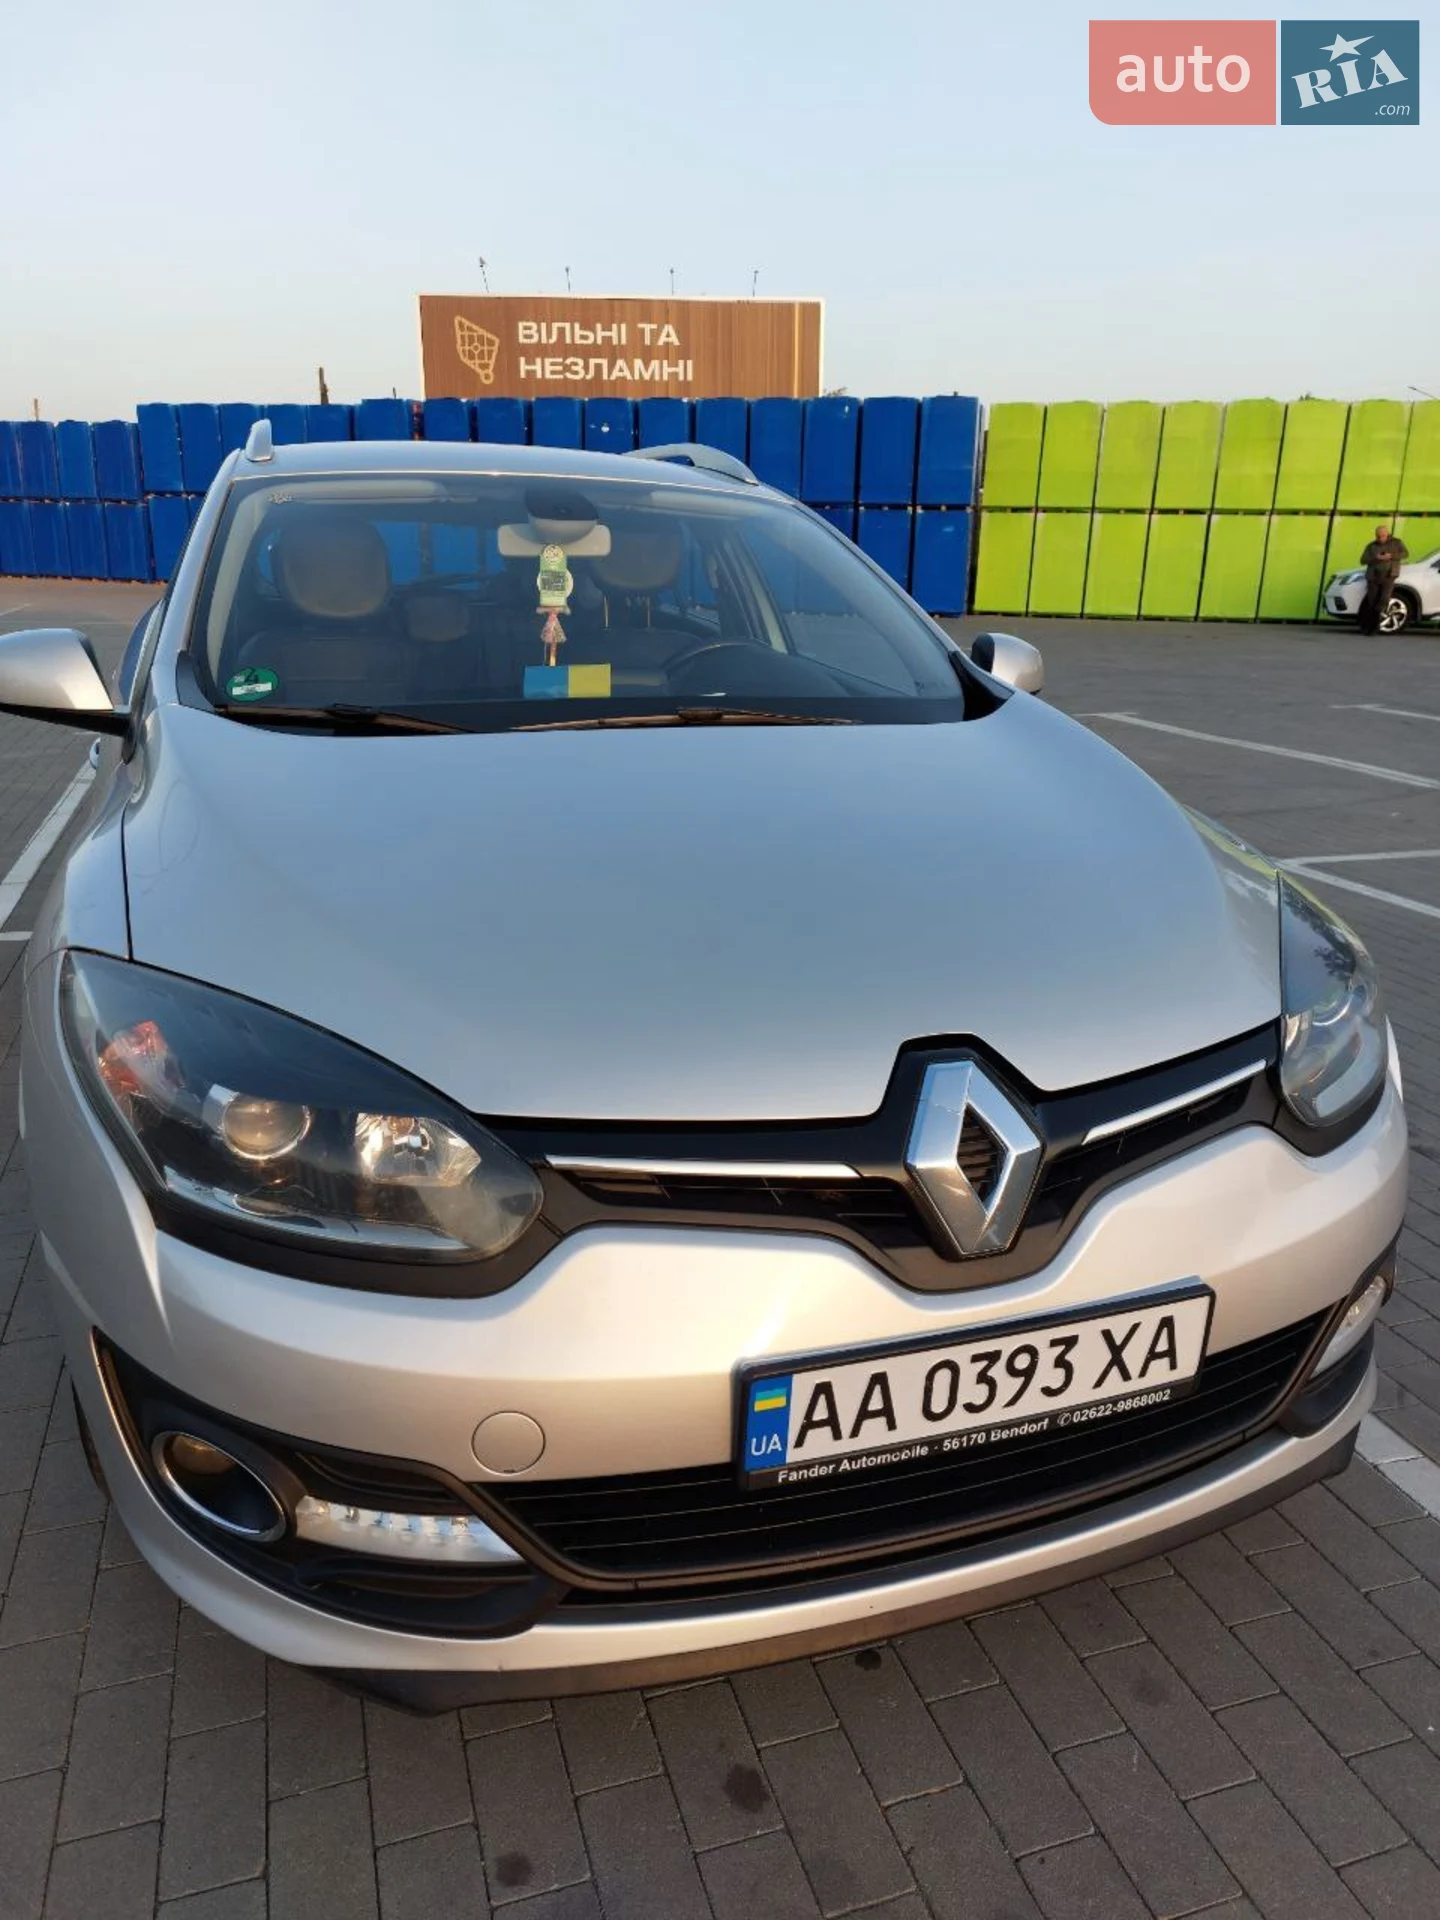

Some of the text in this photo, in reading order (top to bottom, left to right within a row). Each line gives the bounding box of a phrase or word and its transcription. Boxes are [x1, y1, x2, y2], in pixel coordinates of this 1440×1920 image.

[517, 321, 681, 346] ВІЛЬНІ ТА
[519, 357, 693, 381] НЕЗЛАМНІ
[793, 1315, 1178, 1449] AA 0393 XA
[750, 1432, 783, 1457] UA
[777, 1463, 835, 1483] Fander
[942, 1431, 986, 1451] 56170
[990, 1418, 1049, 1441] Bendorf
[1073, 1389, 1171, 1423] 02622-9868002
